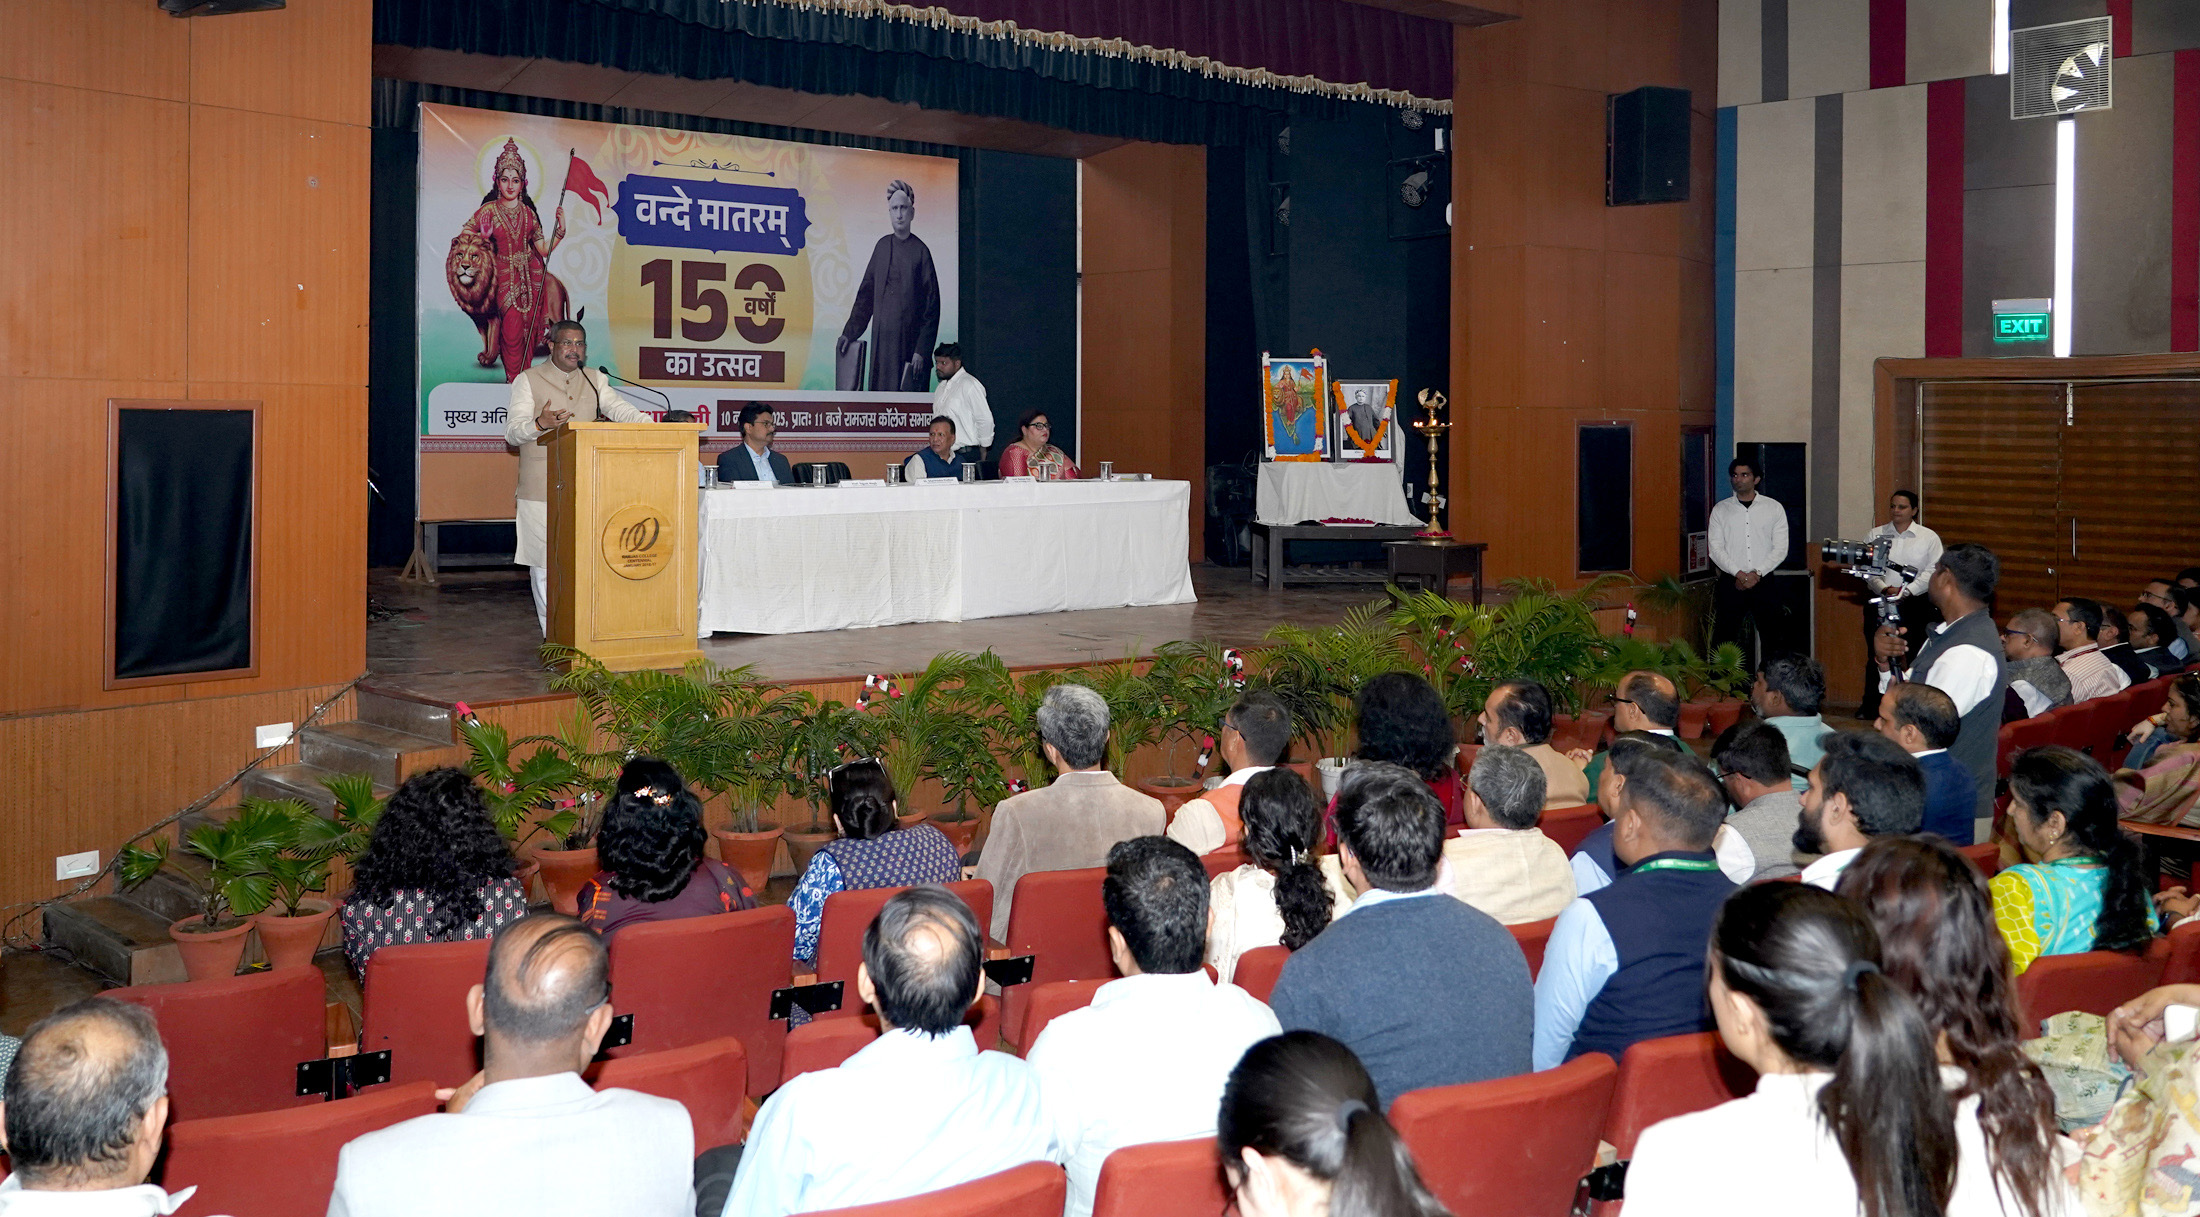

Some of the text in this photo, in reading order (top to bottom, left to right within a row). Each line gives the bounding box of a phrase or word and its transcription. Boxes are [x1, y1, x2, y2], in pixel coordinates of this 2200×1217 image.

[633, 185, 792, 249] वन्दे मातरम्
[640, 258, 786, 345] 150
[743, 291, 777, 316] वर्षों
[2000, 318, 2043, 334] EXIT
[664, 351, 763, 378] का उत्सव
[443, 406, 509, 429] मुख्य अति
[721, 410, 731, 426] 10
[772, 411, 789, 428] 25,
[814, 413, 823, 427] 11
[825, 406, 843, 427] बजे
[843, 412, 877, 428] रामजस
[877, 407, 908, 428] कॉलेज
[908, 412, 934, 428] सभाग
